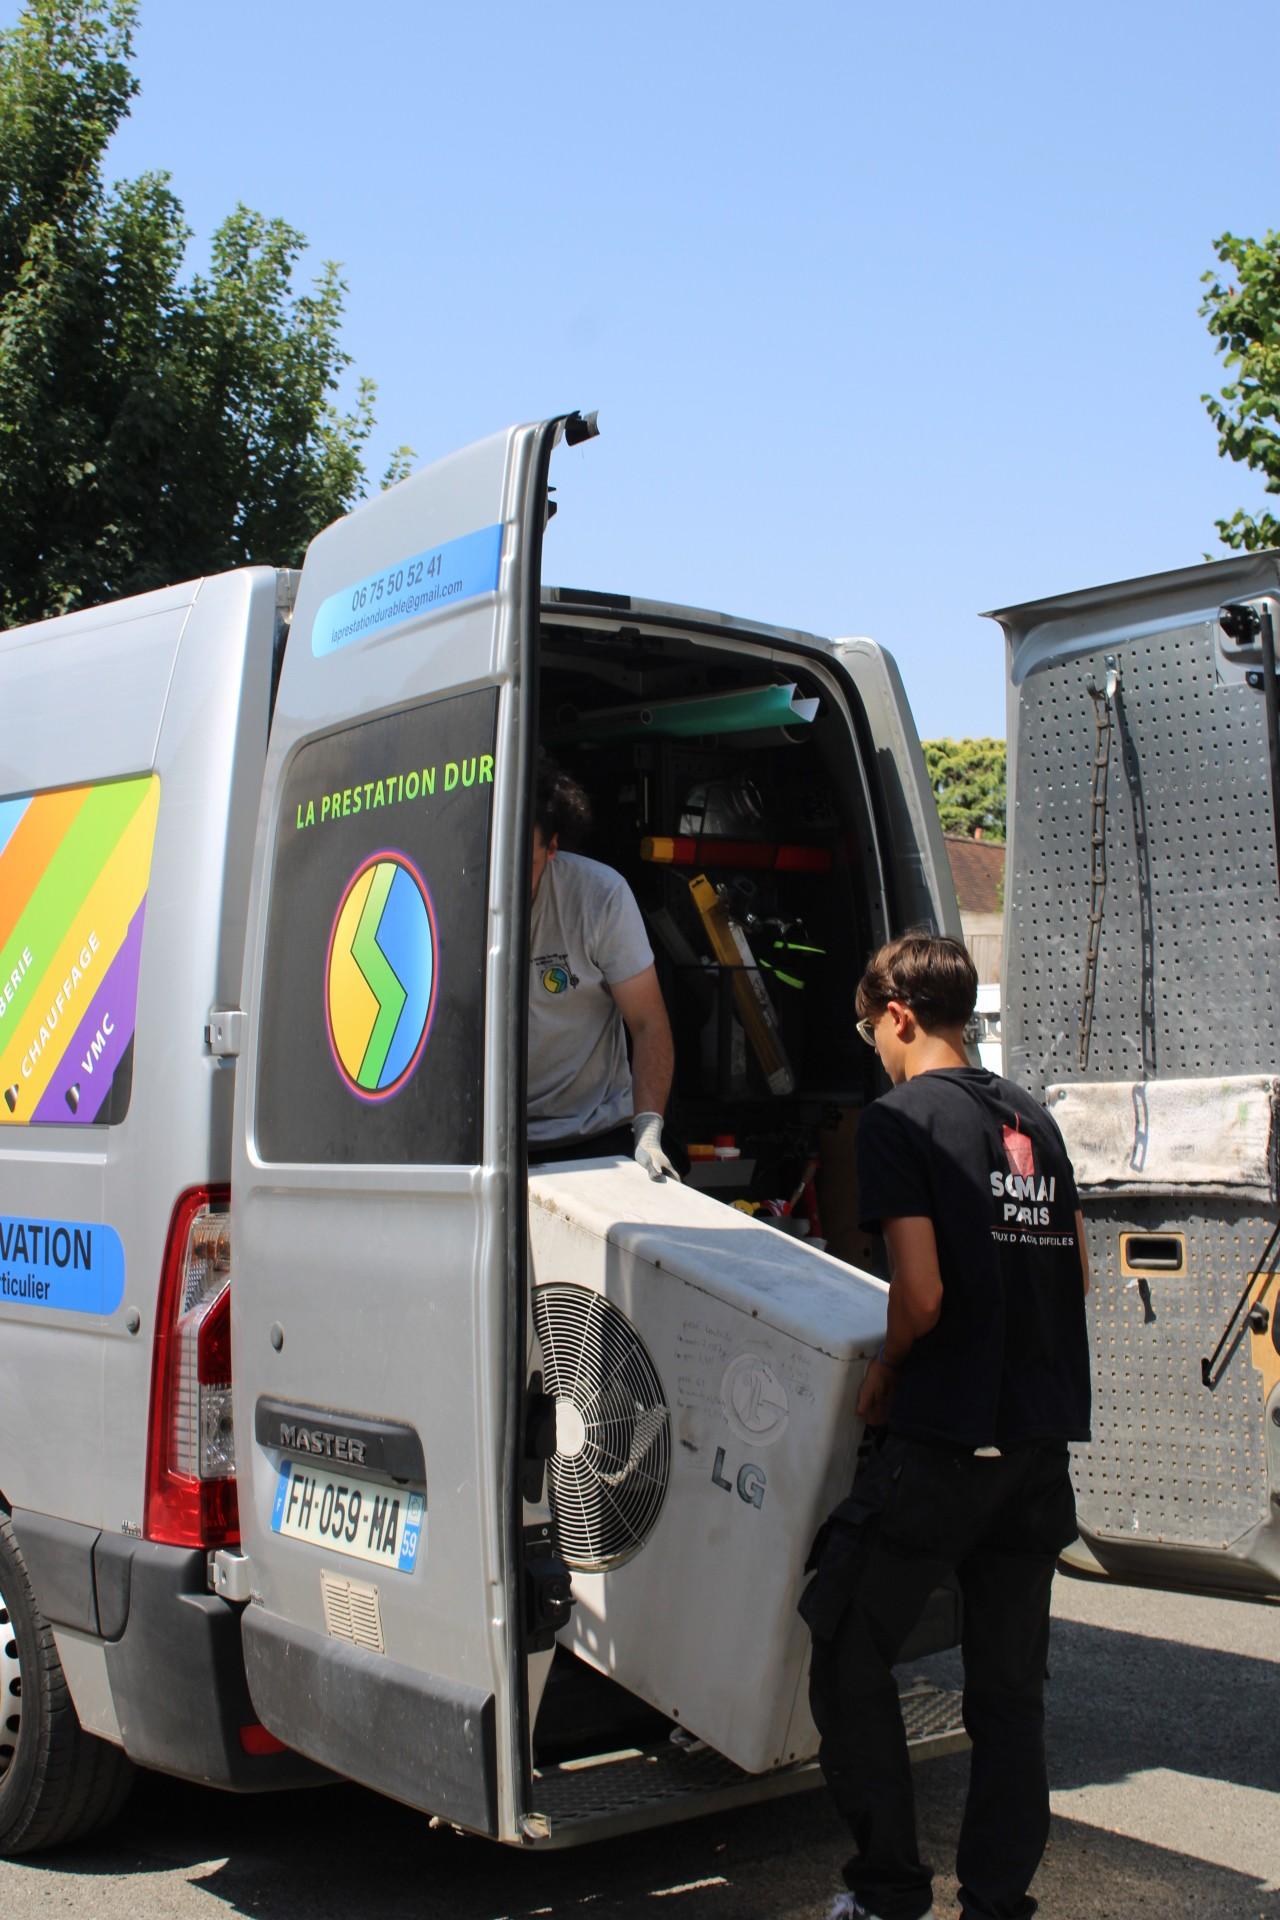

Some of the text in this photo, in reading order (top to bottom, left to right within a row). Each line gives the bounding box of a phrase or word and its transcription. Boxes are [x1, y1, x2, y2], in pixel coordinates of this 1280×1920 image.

[331, 579, 463, 644] laprestationdurable@gmail.com
[352, 553, 443, 612] 06 75 50 52 41
[296, 754, 494, 829] LA PRESTATION DUR
[21, 931, 100, 1079] CHAUFFAGE
[81, 1012, 115, 1075] VMC
[0, 1222, 92, 1271] VATION
[0, 1271, 51, 1300] ticulier
[279, 1422, 367, 1464] MASTER
[711, 1446, 767, 1510] LG
[286, 1474, 400, 1555] FH-059-MA
[401, 1529, 417, 1557] 59
